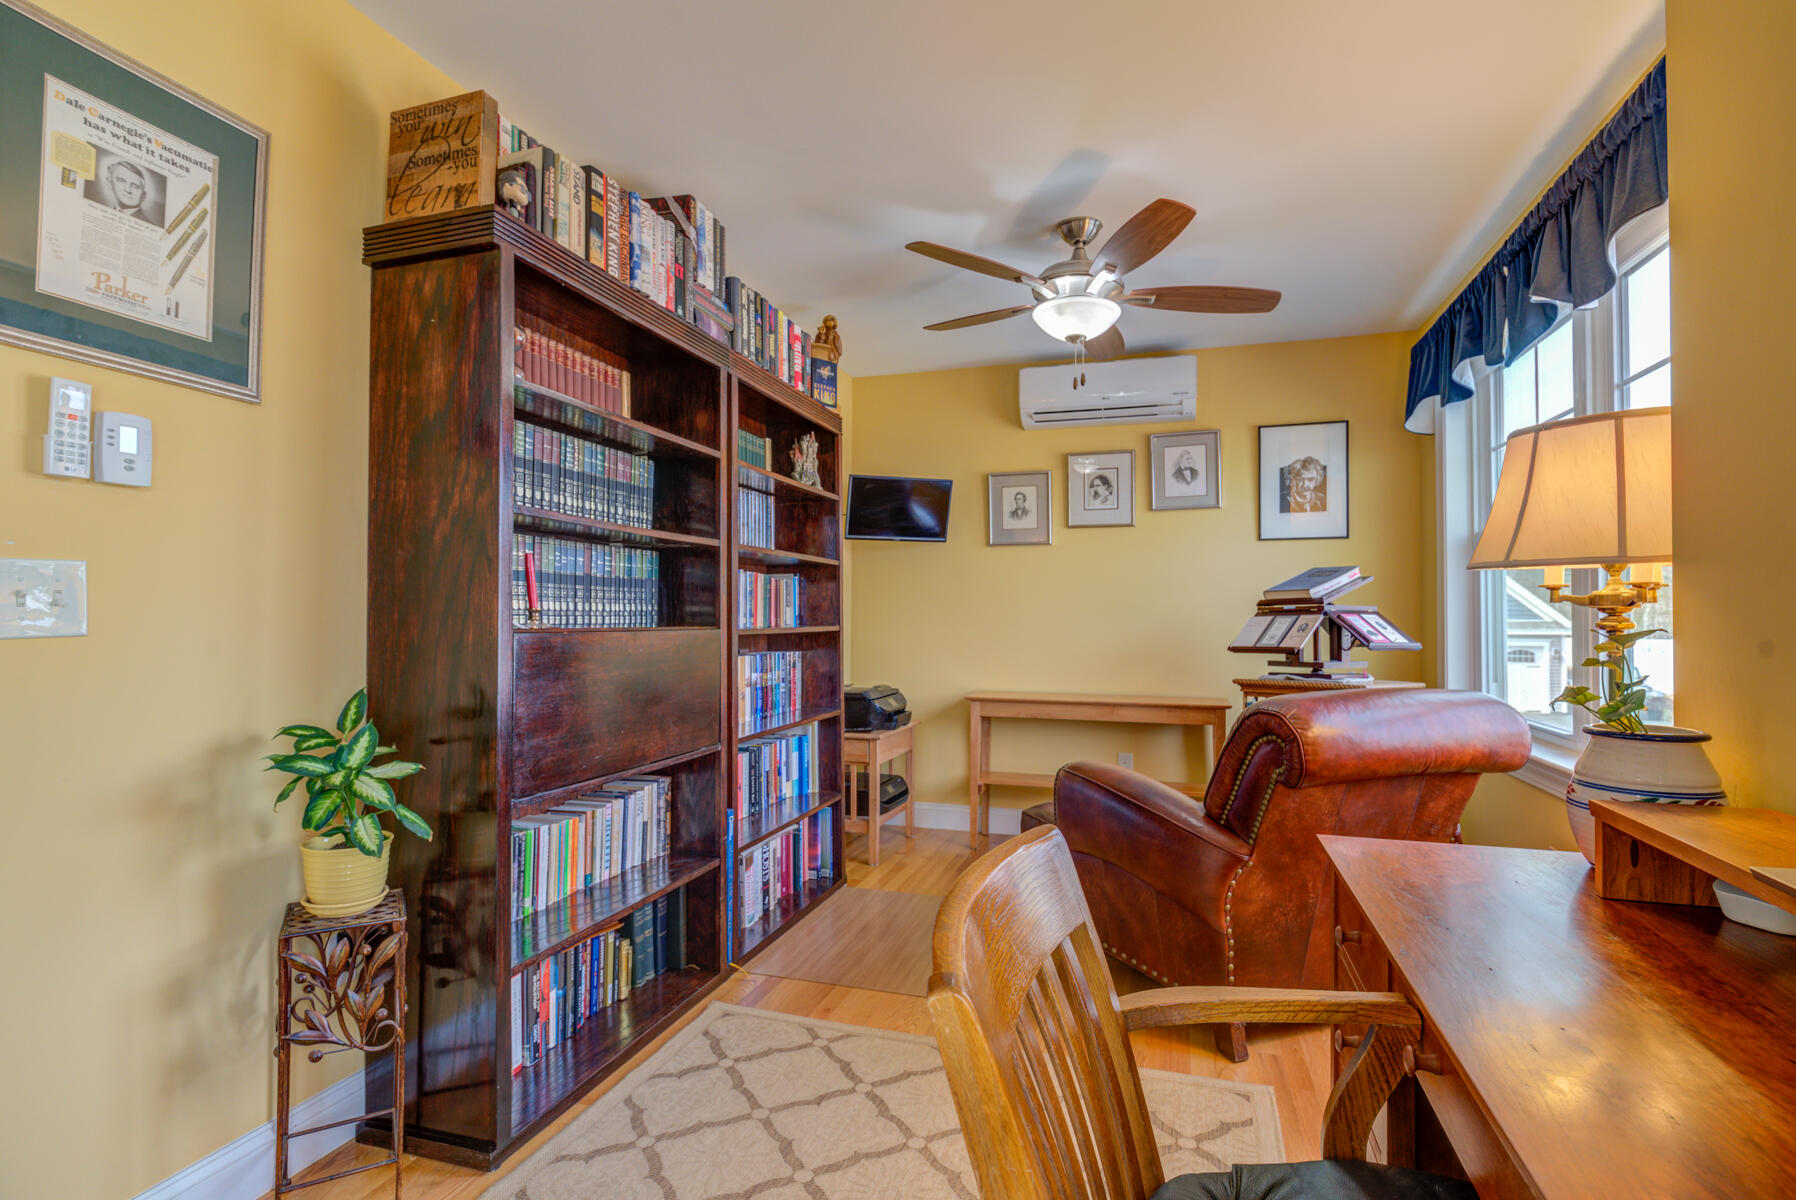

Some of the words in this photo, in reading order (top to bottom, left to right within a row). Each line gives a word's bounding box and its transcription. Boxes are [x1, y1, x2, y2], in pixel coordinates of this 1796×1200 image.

[54, 89, 85, 112] Dale
[88, 105, 152, 145] Carnegie's
[153, 136, 212, 173] Vacumatic
[391, 102, 457, 125] Sometimes
[398, 121, 421, 138] you
[420, 111, 480, 147] win
[83, 116, 105, 134] has
[110, 128, 142, 151] what
[145, 145, 155, 157] it
[159, 151, 189, 173] takes
[407, 145, 477, 170] Sometimes
[451, 158, 477, 175] you
[573, 168, 582, 205] STAND
[607, 176, 620, 241] STEPHEN
[620, 188, 629, 232] RICHARD
[607, 243, 619, 278] KING
[620, 233, 629, 282] BACHMAN
[91, 271, 149, 304] Parker
[814, 388, 836, 402] KING
